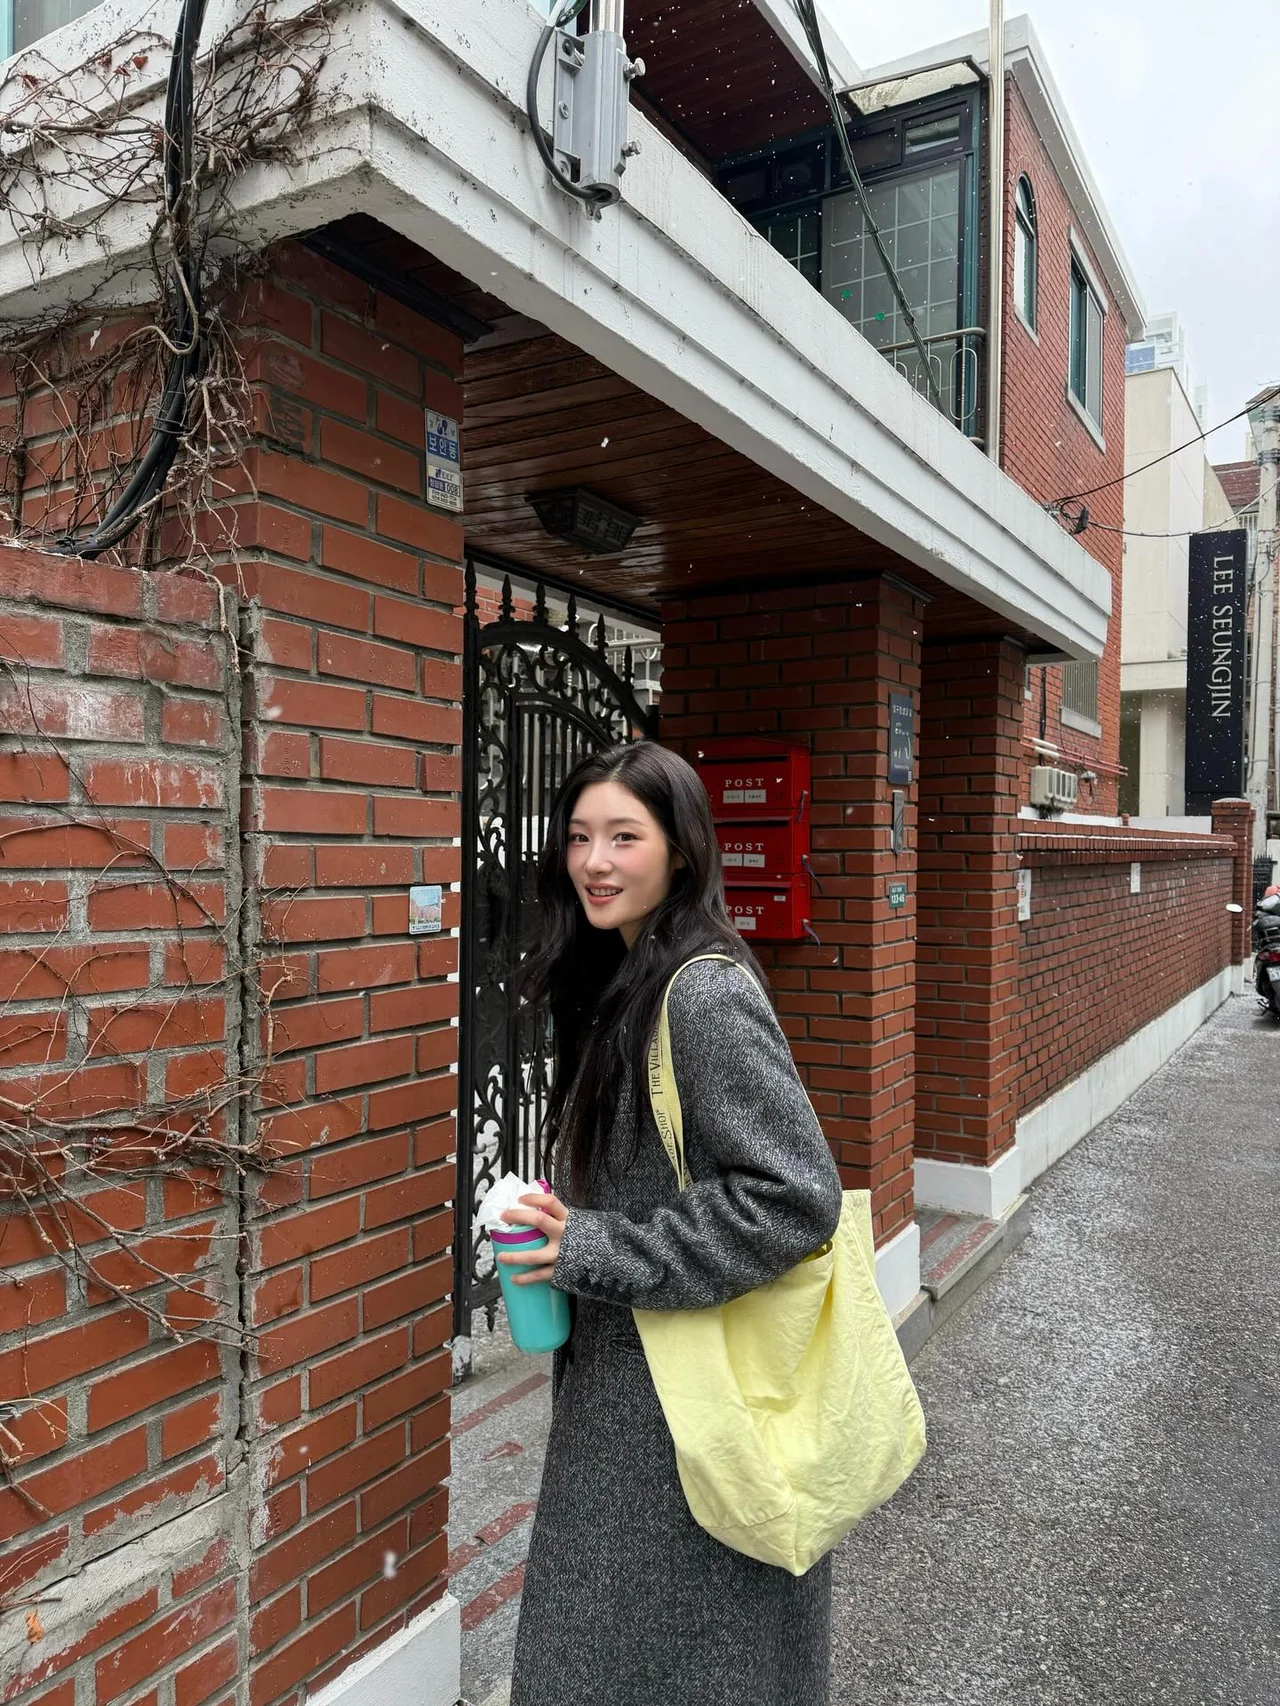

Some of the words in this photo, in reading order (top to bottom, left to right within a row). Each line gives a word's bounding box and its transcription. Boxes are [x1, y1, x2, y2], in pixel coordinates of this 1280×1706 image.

[1213, 555, 1234, 595] LEE
[1208, 605, 1233, 718] SEUNGJIN
[725, 778, 764, 787] POST
[725, 842, 764, 851] POST
[725, 905, 764, 914] POST
[651, 1073, 663, 1098] THE
[656, 1109, 672, 1139] SHOP
